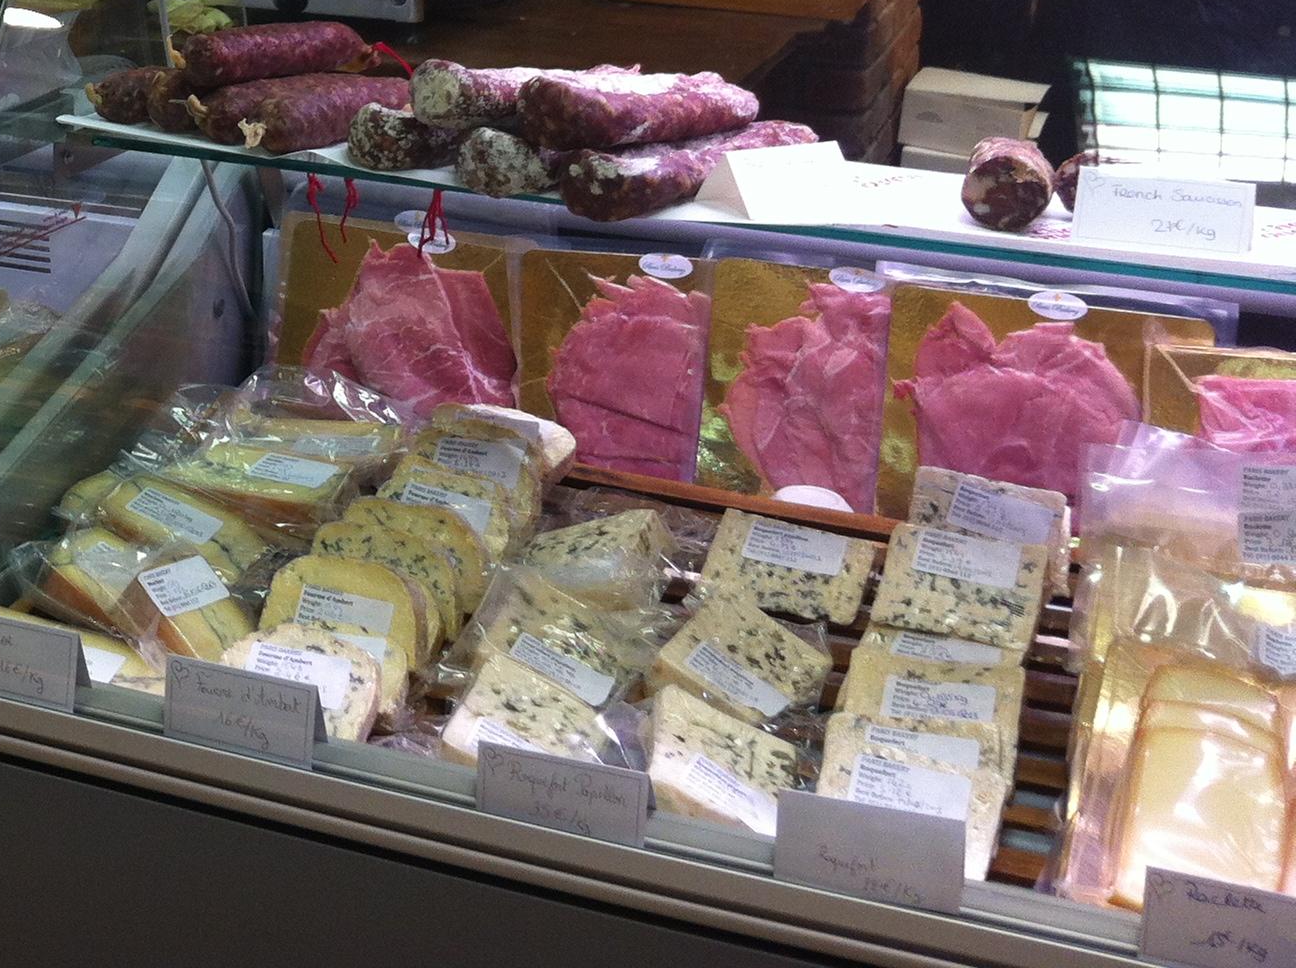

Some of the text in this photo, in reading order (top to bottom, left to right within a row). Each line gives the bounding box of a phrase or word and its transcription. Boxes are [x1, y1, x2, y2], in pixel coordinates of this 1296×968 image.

[1112, 184, 1163, 201] French
[1263, 514, 1290, 522] BAKERY
[283, 654, 313, 666] d'Ambert
[195, 671, 233, 699] Fourme
[859, 764, 897, 778] Roquefort
[861, 755, 912, 773] PARIS BAKERY
[507, 759, 569, 801] Roquefort
[816, 841, 879, 877] Roquefort
